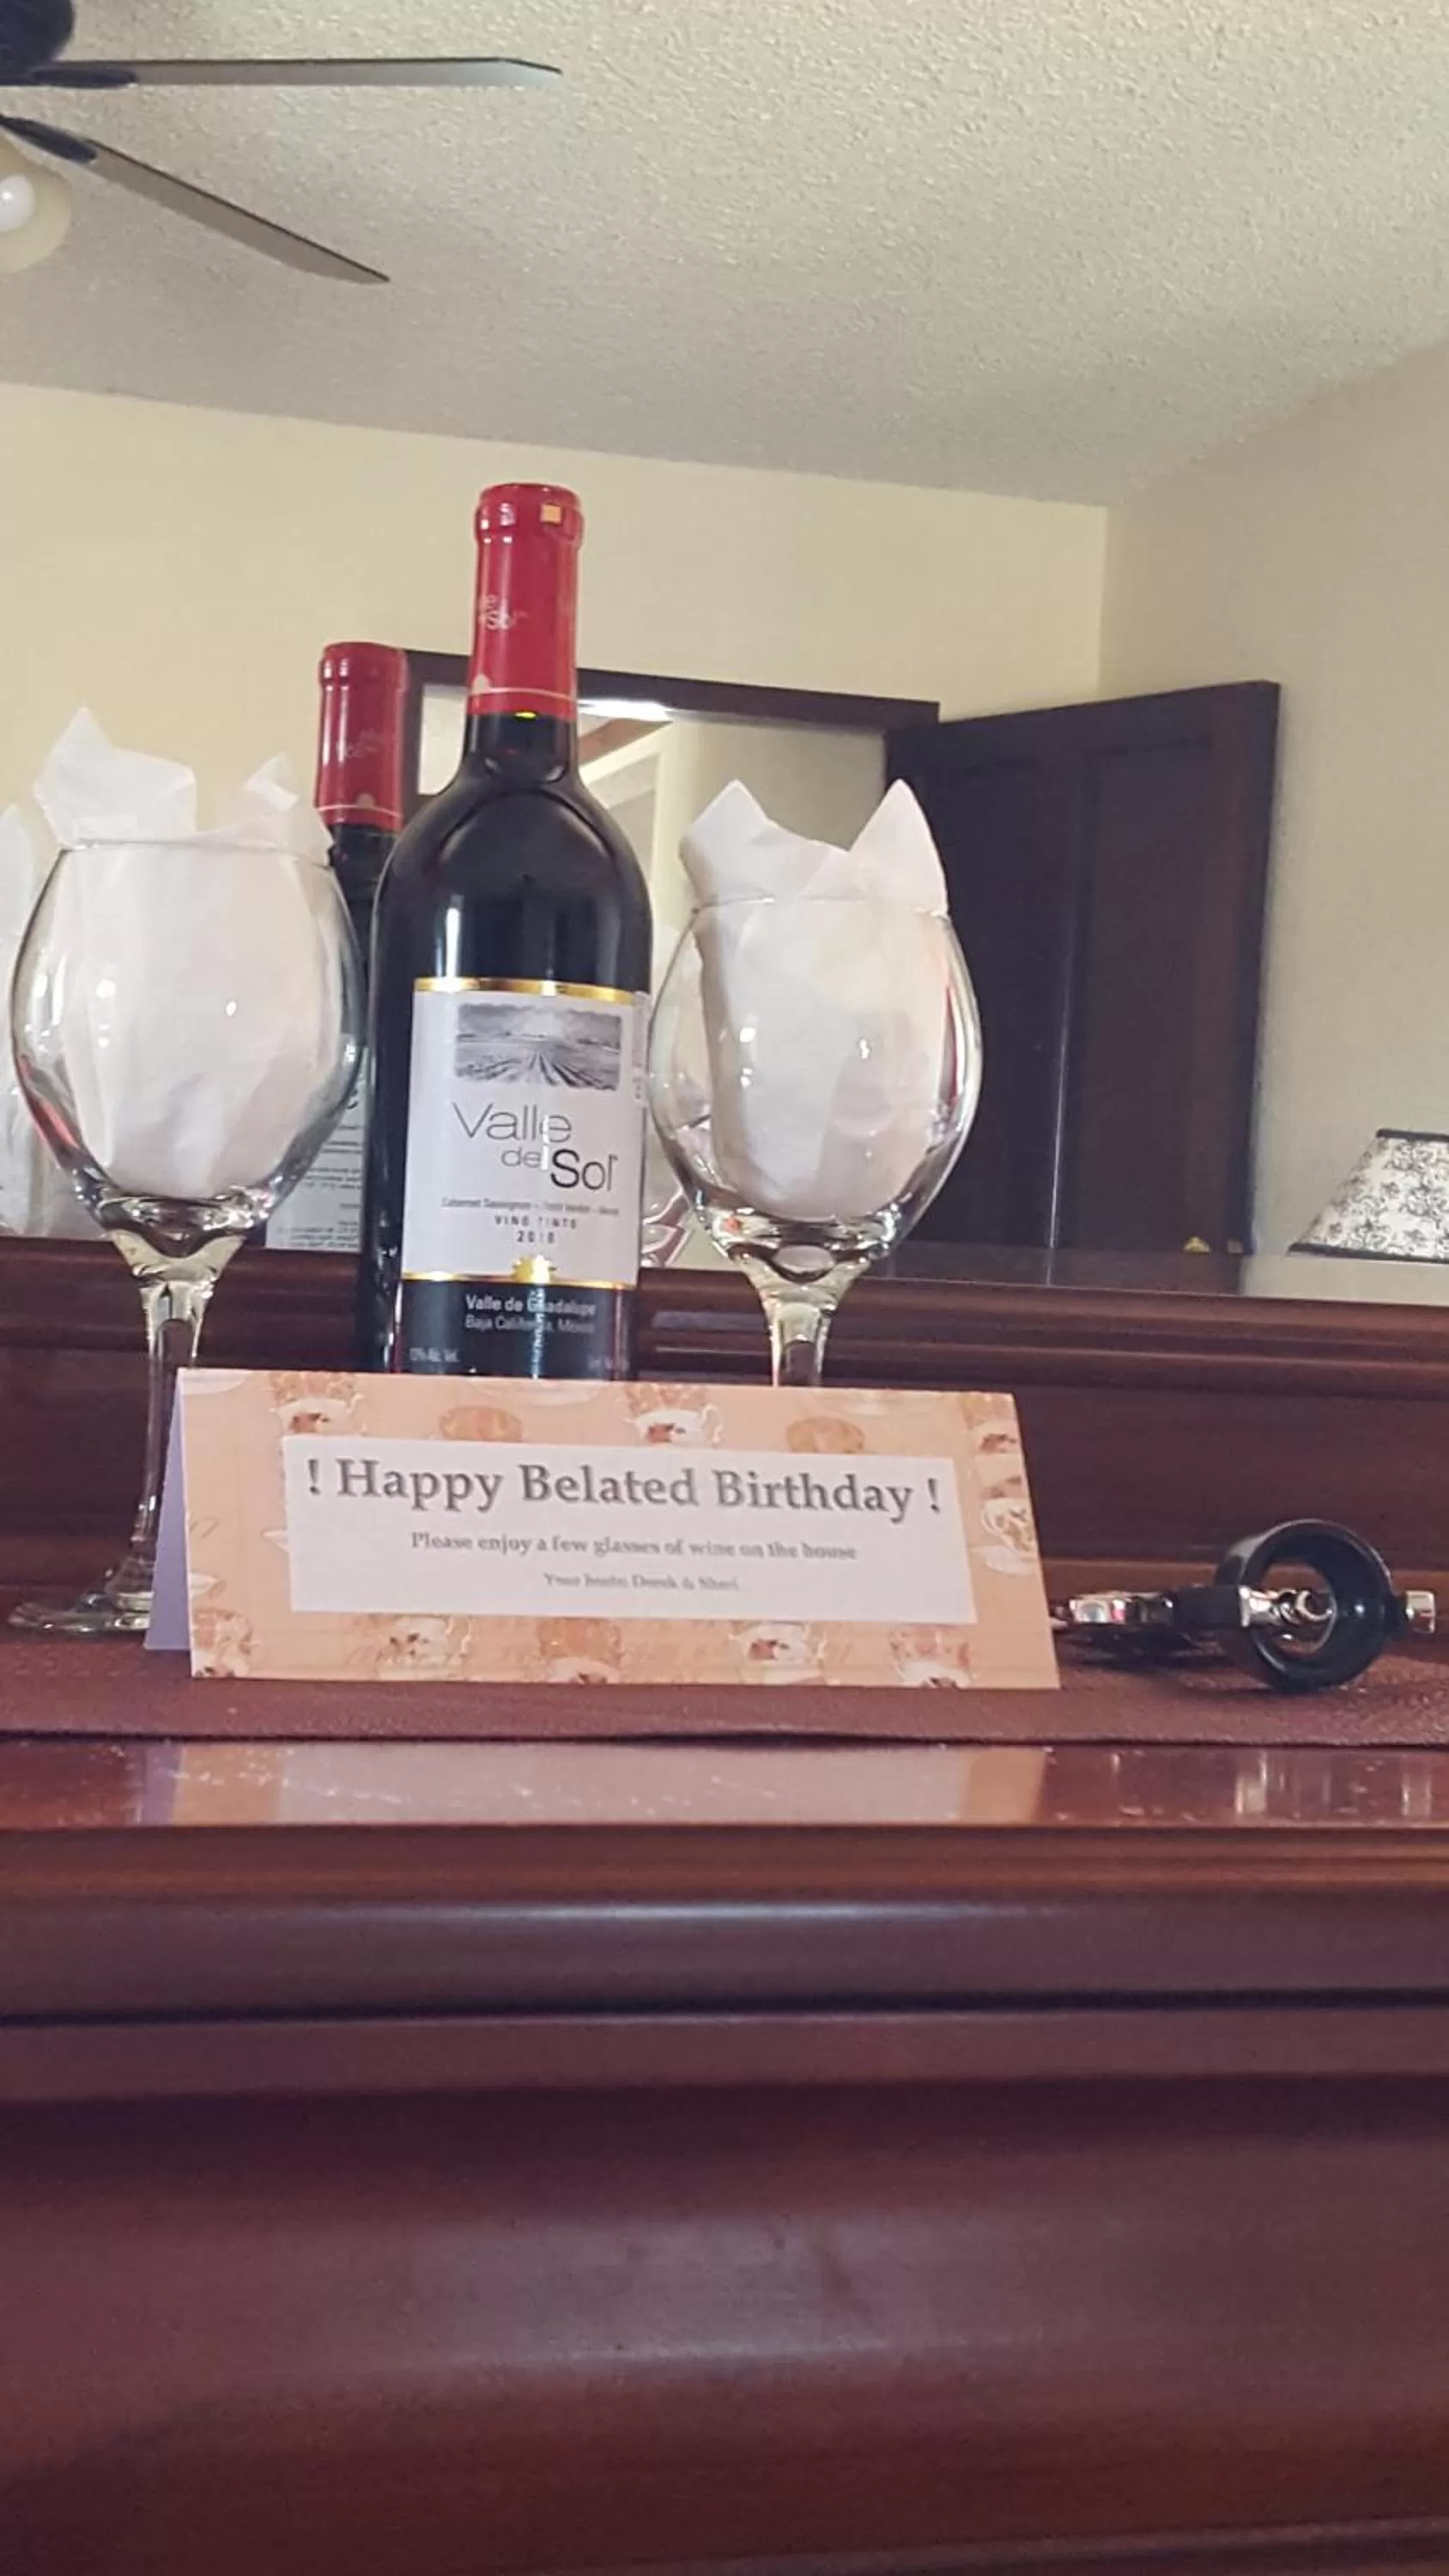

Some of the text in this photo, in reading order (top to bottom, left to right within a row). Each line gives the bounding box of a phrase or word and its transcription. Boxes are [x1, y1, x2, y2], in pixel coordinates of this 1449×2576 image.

[452, 1102, 573, 1143] Valle
[500, 1147, 611, 1192] de Sol
[466, 1294, 502, 1309] Valle
[505, 1296, 523, 1312] de
[336, 1458, 504, 1513] Happy
[518, 1463, 700, 1505] Belated
[712, 1468, 914, 1523] Birthday
[411, 1531, 857, 1560] Please enjoy a few glasses of wine on the house
